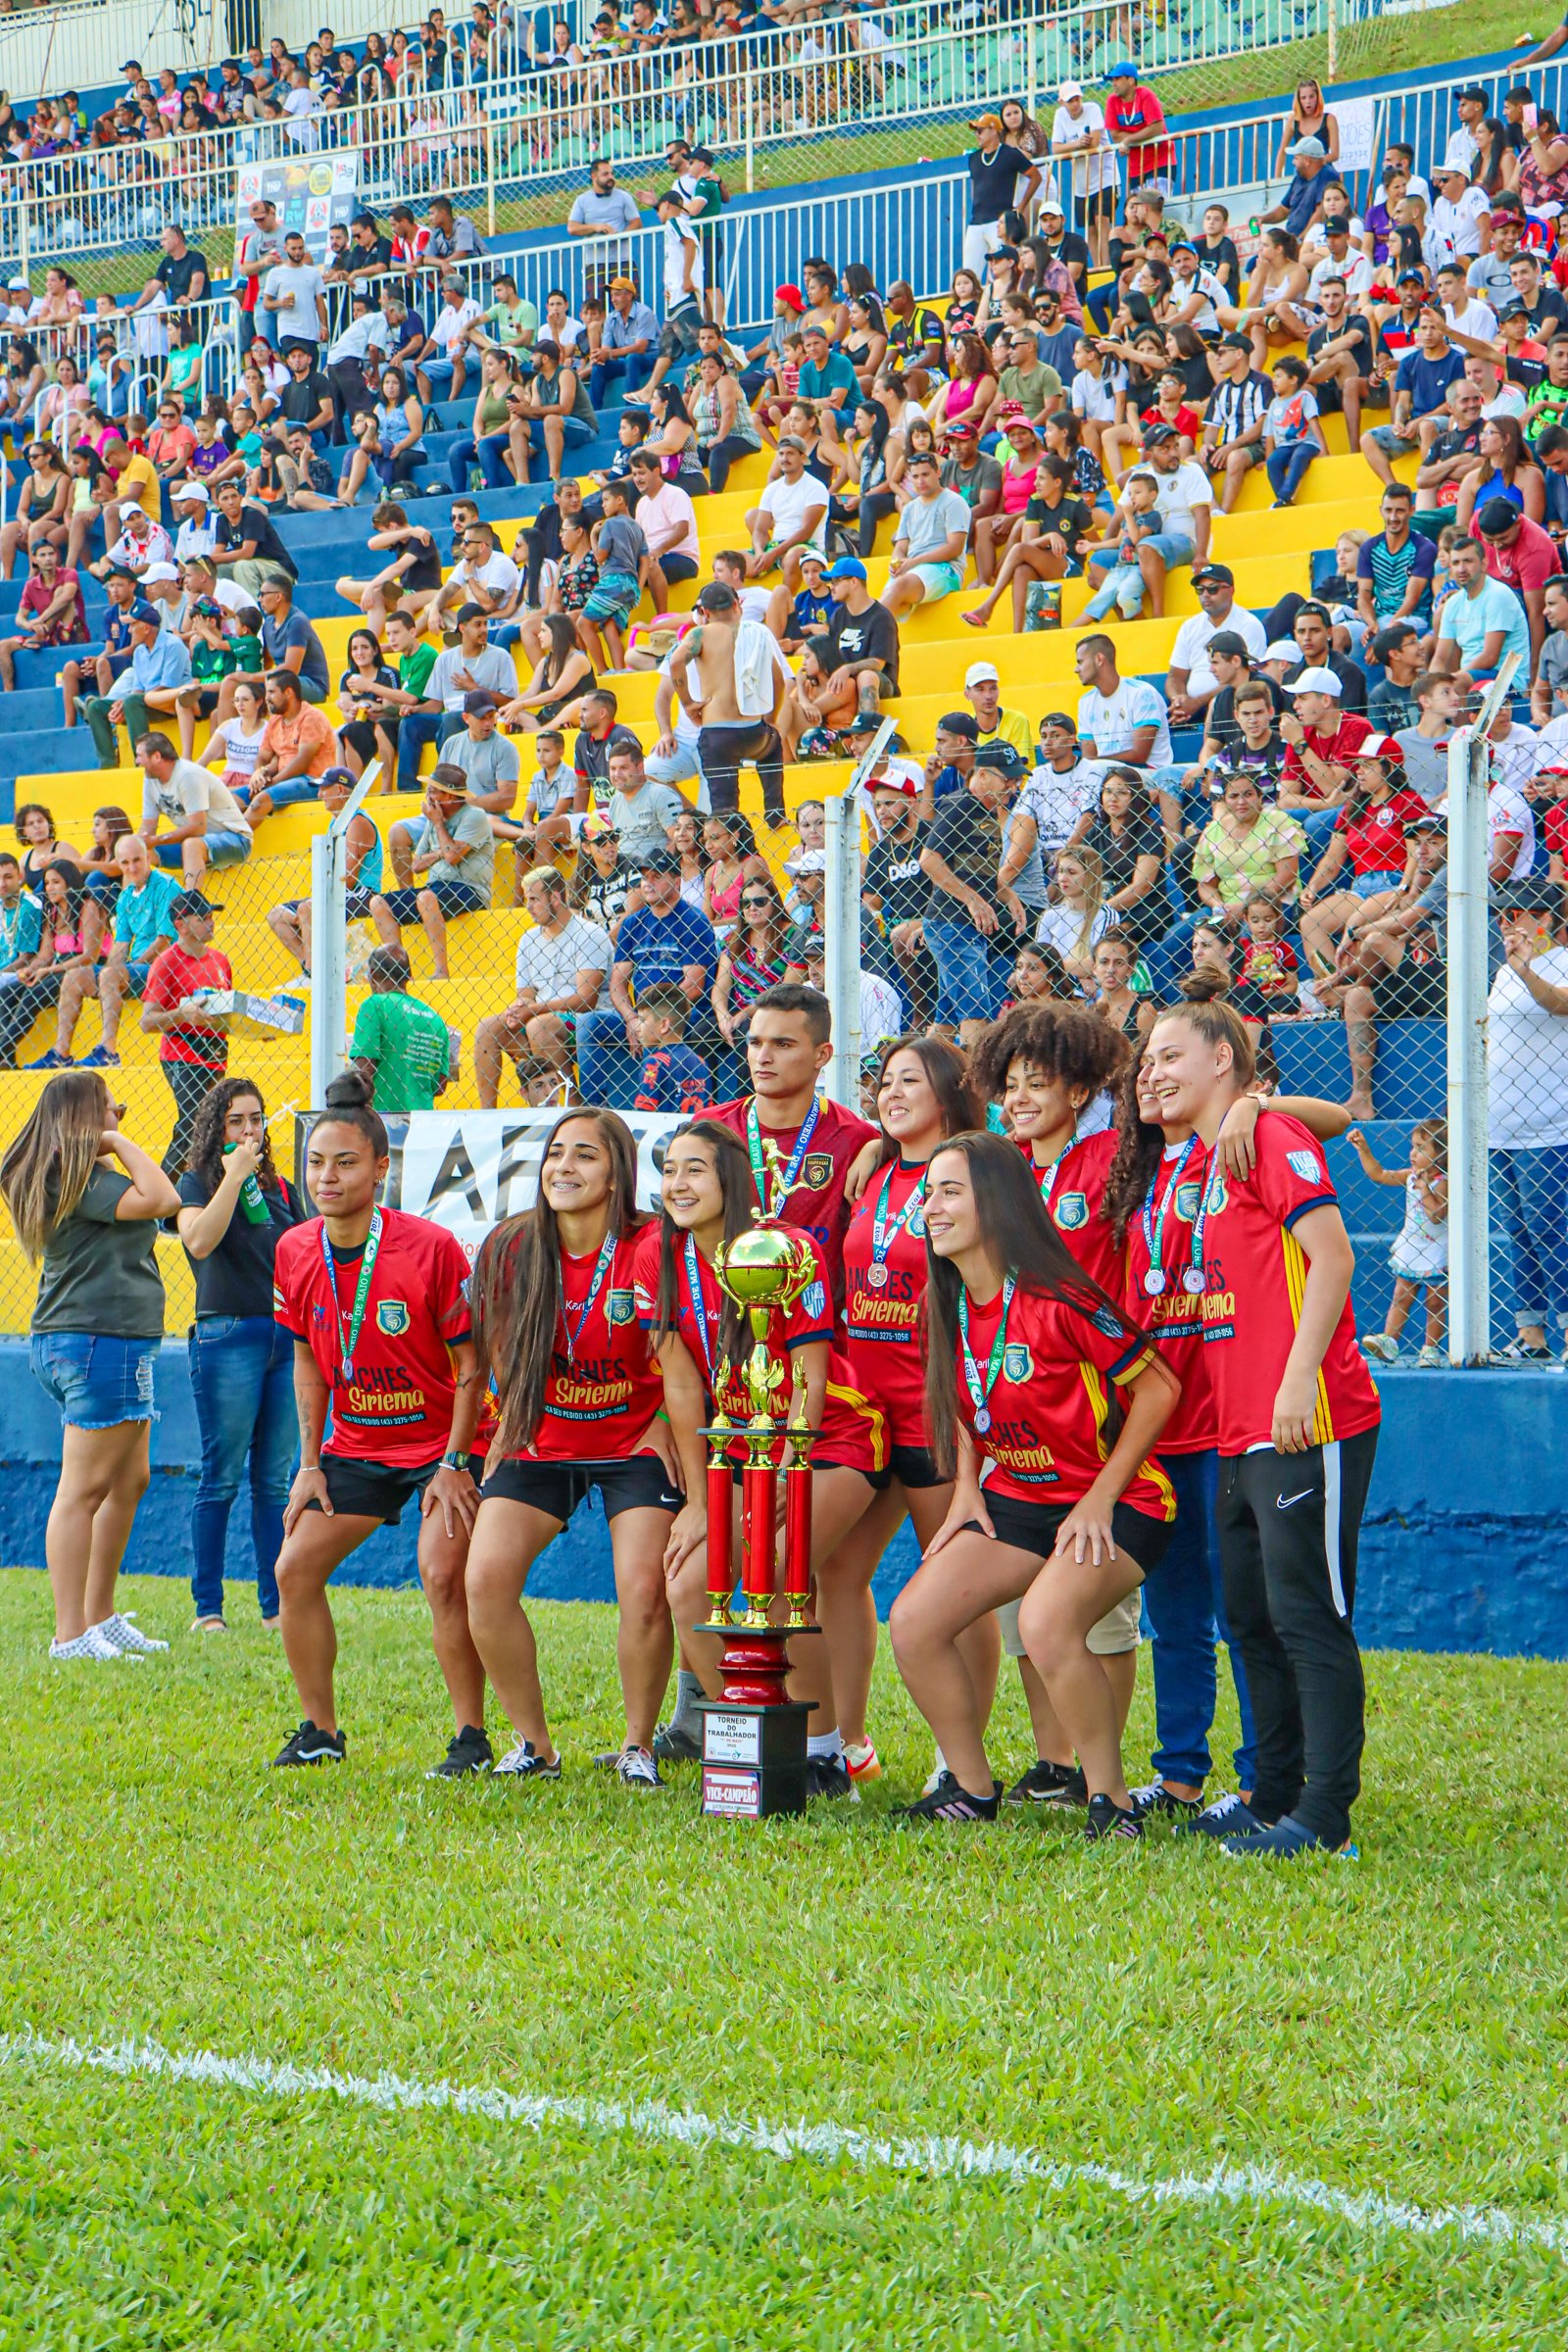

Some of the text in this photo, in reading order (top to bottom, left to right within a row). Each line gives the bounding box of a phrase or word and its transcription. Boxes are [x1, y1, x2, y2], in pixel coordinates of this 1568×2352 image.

[889, 859, 920, 882] D&G
[688, 1259, 698, 1284] MAIO
[358, 1278, 368, 1302] MAIO
[852, 1291, 918, 1325] Siriema
[879, 1332, 908, 1342] 3275-1056
[987, 1356, 1001, 1386] MAIO
[349, 1387, 425, 1412] Siriema
[556, 1378, 633, 1404] Siriema
[394, 1413, 424, 1425] 3275-1056
[717, 1716, 747, 1725] TORNEIO
[708, 1730, 757, 1739] TRABALHADOR
[707, 1787, 757, 1803] VICE-CAMPEÃO
